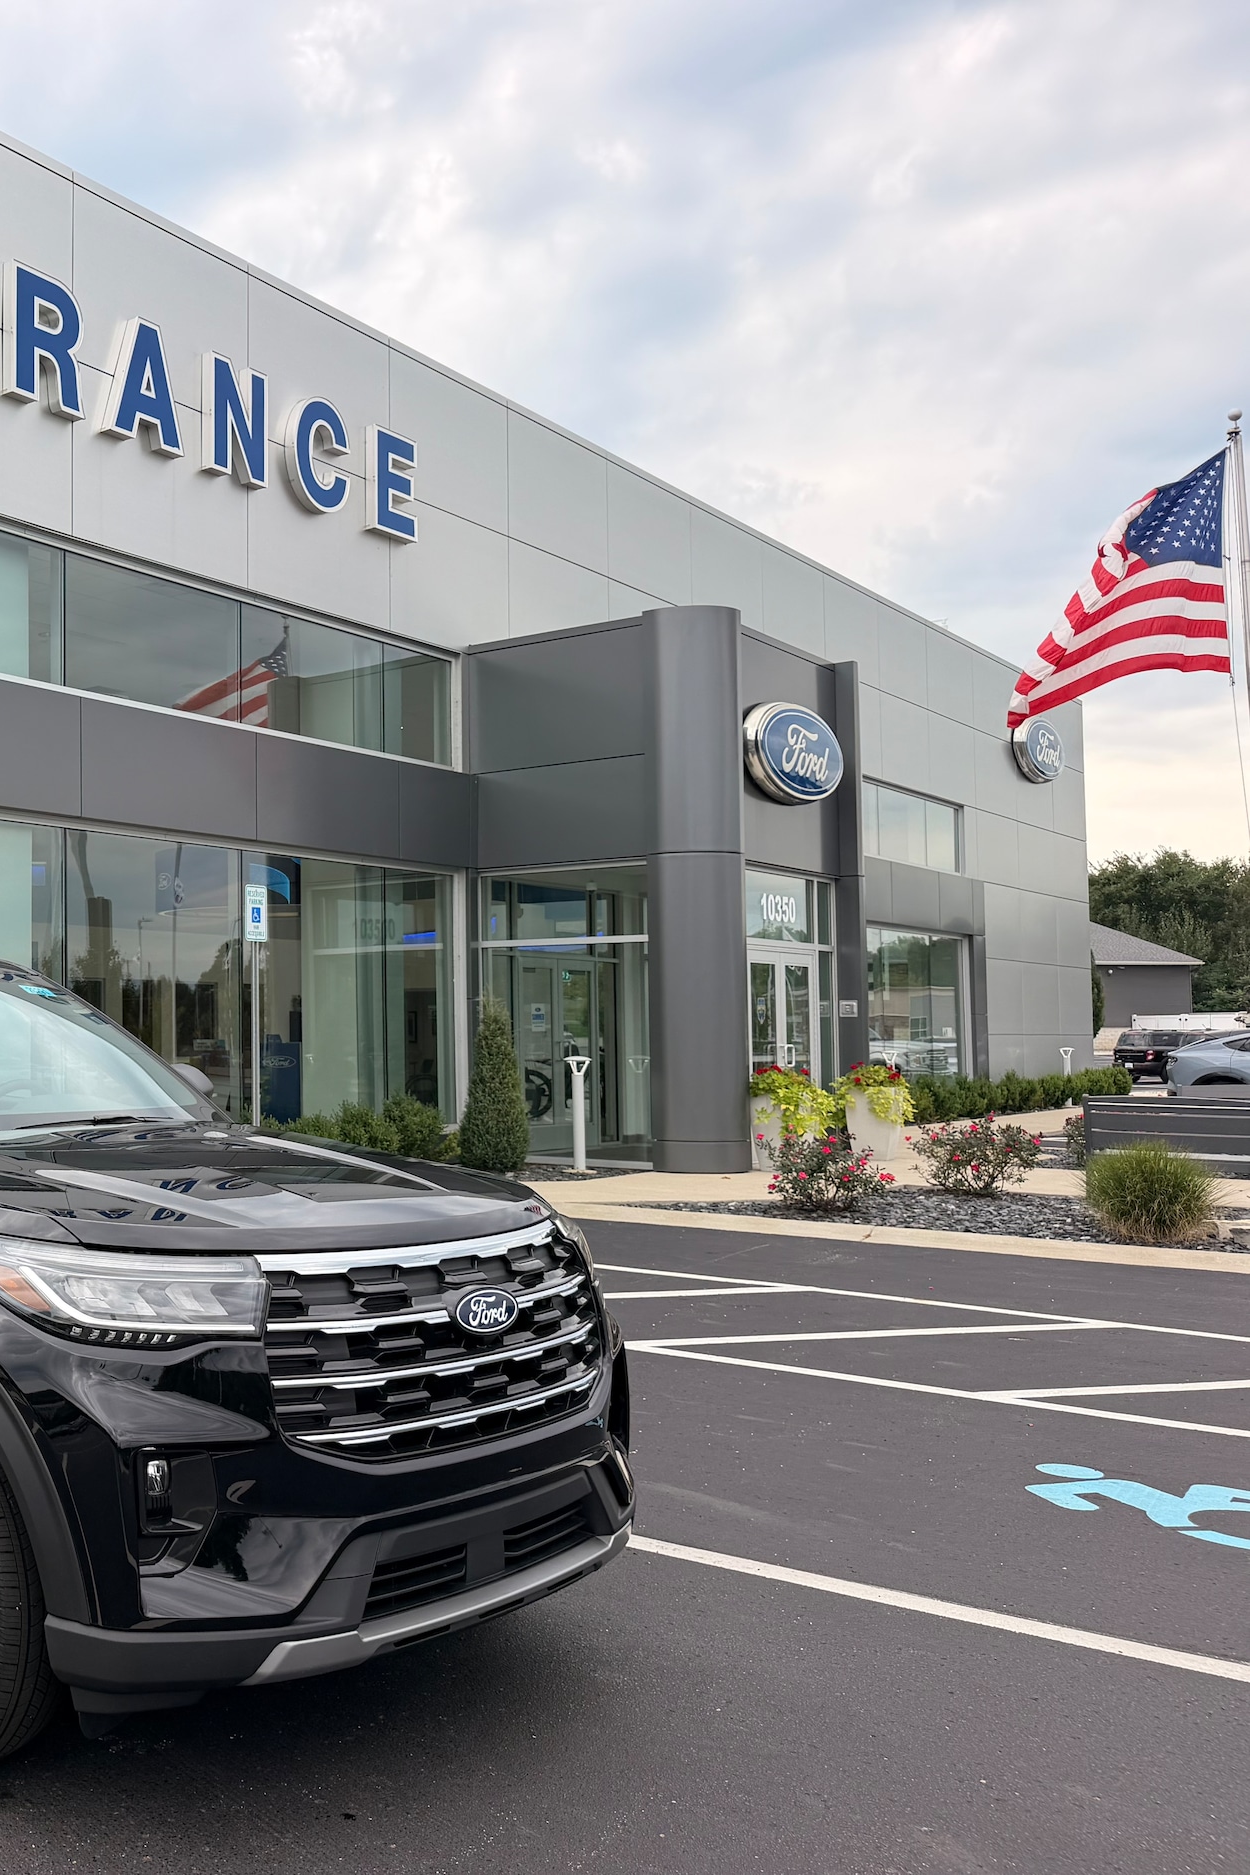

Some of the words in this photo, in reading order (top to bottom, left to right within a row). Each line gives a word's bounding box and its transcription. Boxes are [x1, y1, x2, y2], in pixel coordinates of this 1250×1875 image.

[781, 723, 830, 782] Ford
[1036, 729, 1061, 768] Ford
[760, 892, 797, 924] 10350
[468, 1295, 509, 1327] Ford
